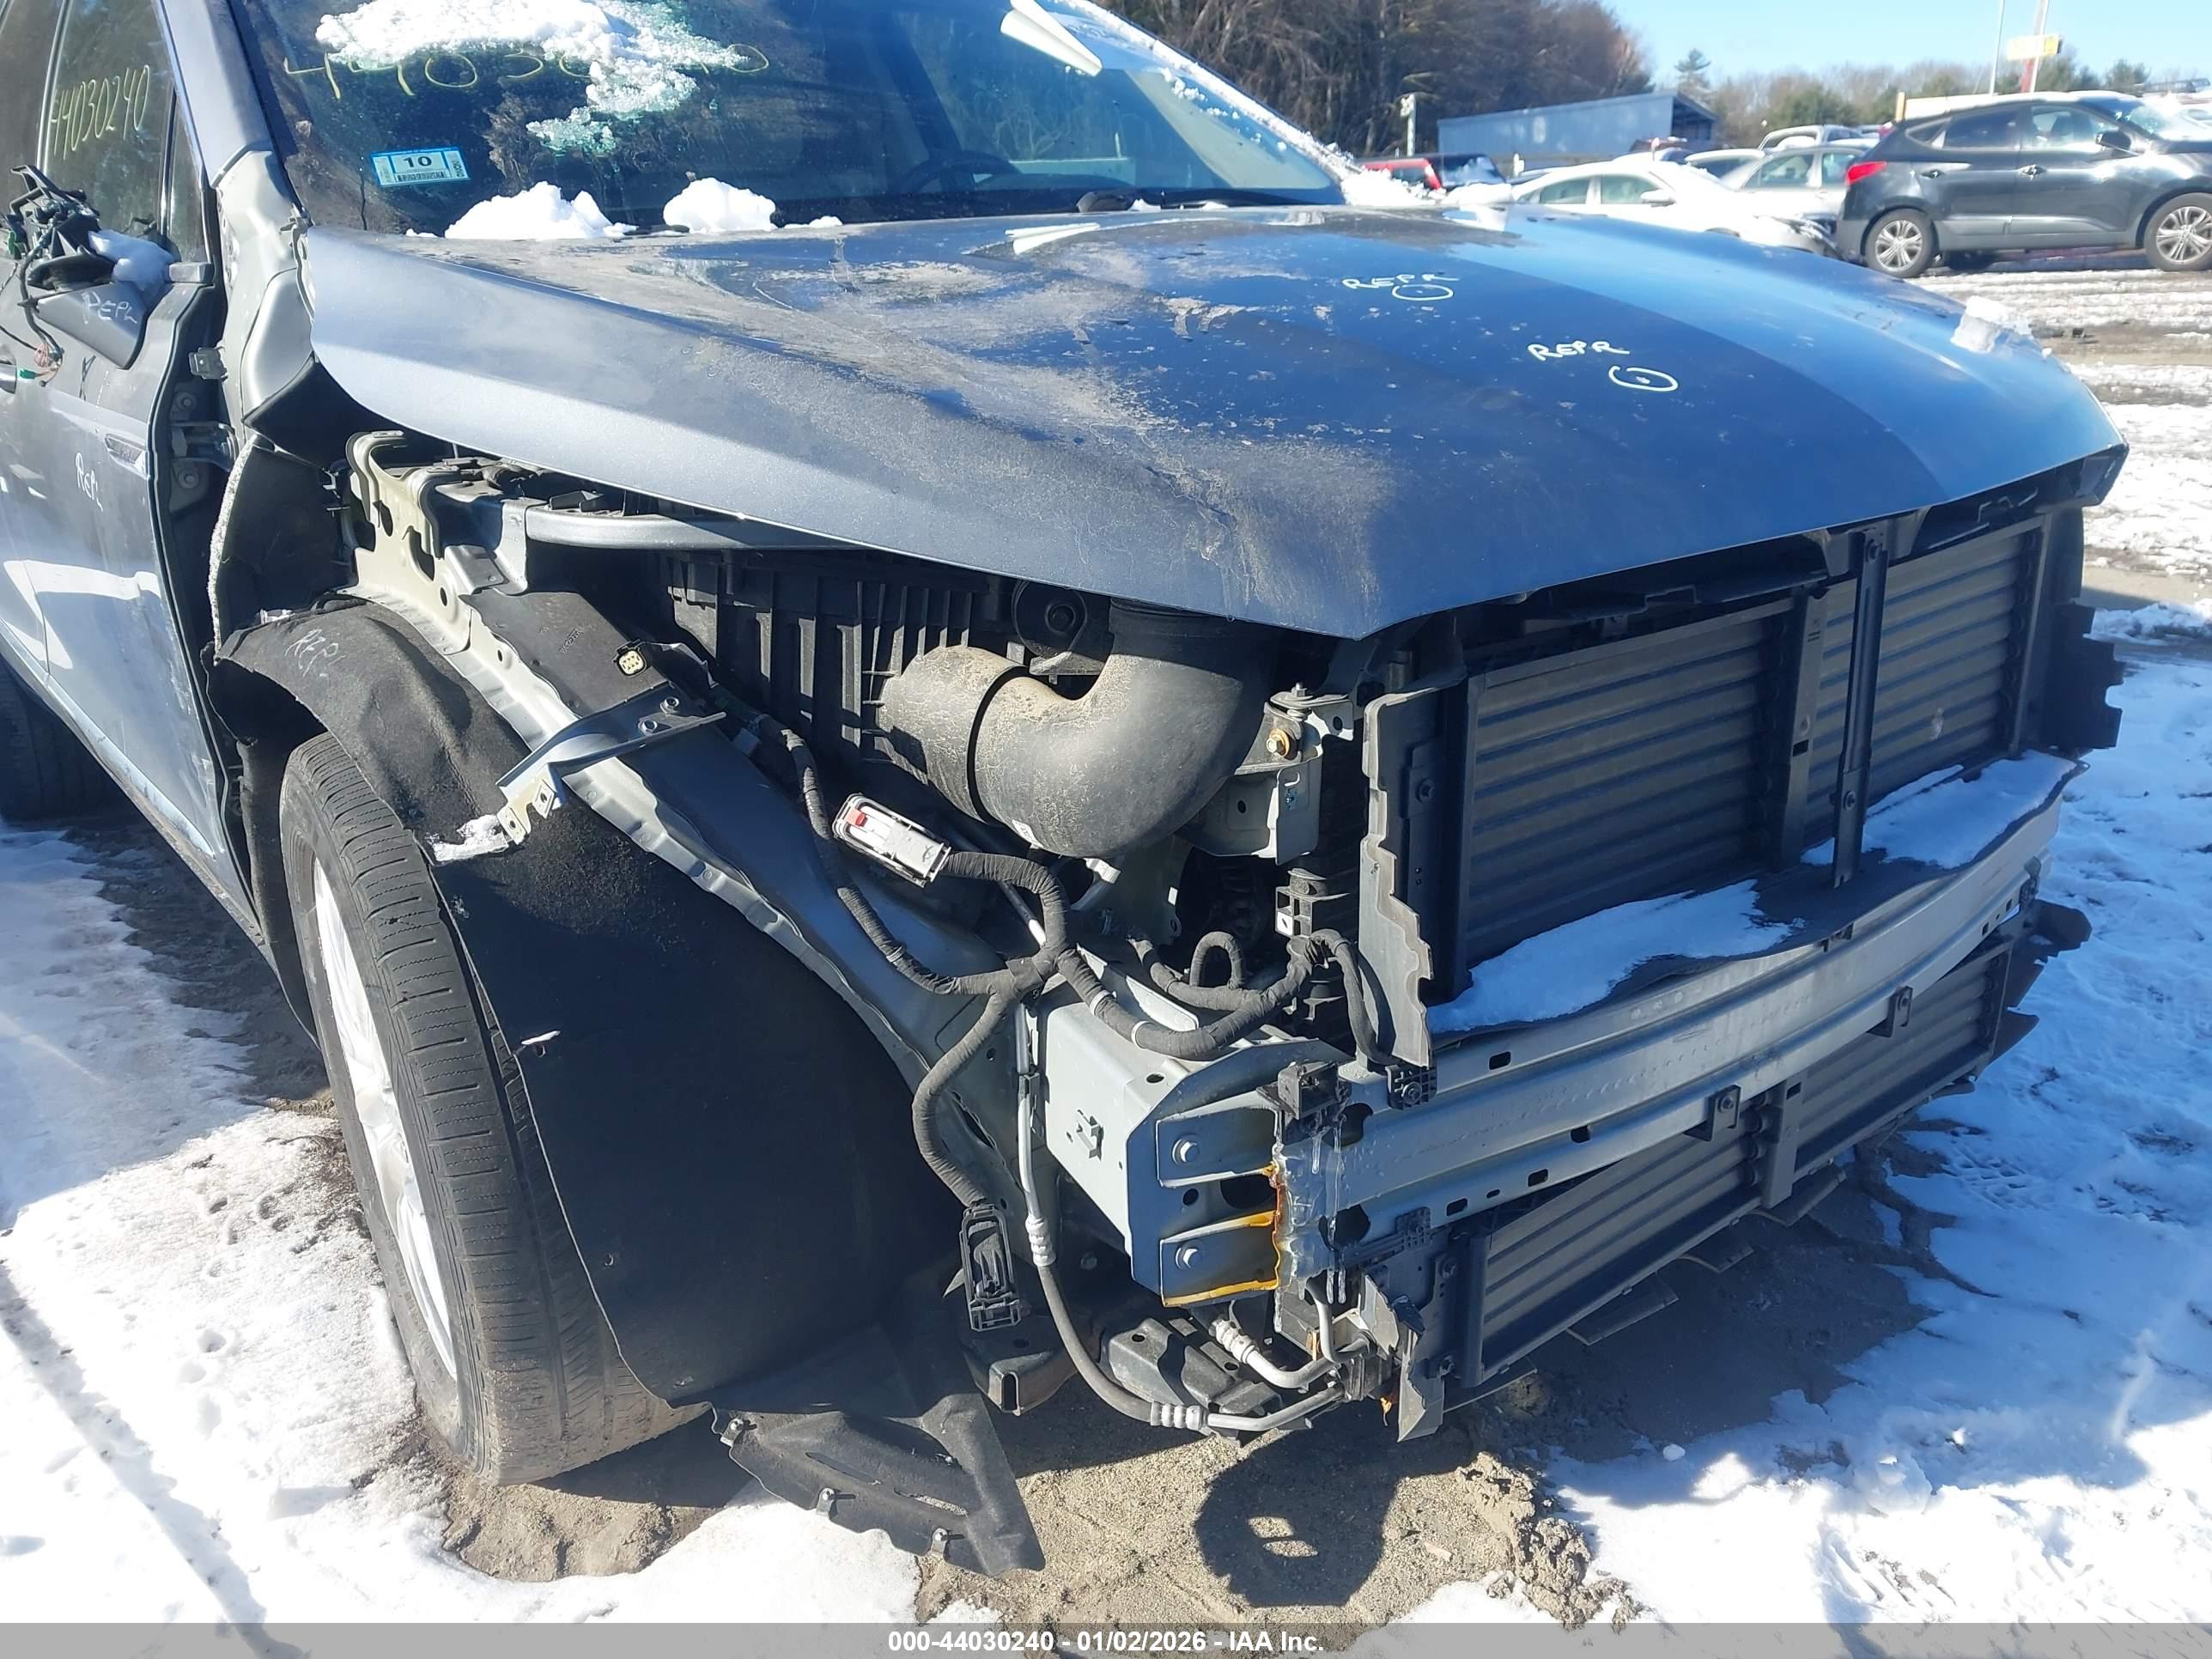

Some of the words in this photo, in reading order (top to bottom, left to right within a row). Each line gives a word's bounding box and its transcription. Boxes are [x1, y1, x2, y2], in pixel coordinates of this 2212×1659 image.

[50, 64, 150, 161] 44030240
[403, 155, 432, 168] 10
[1528, 340, 1631, 361] REPR
